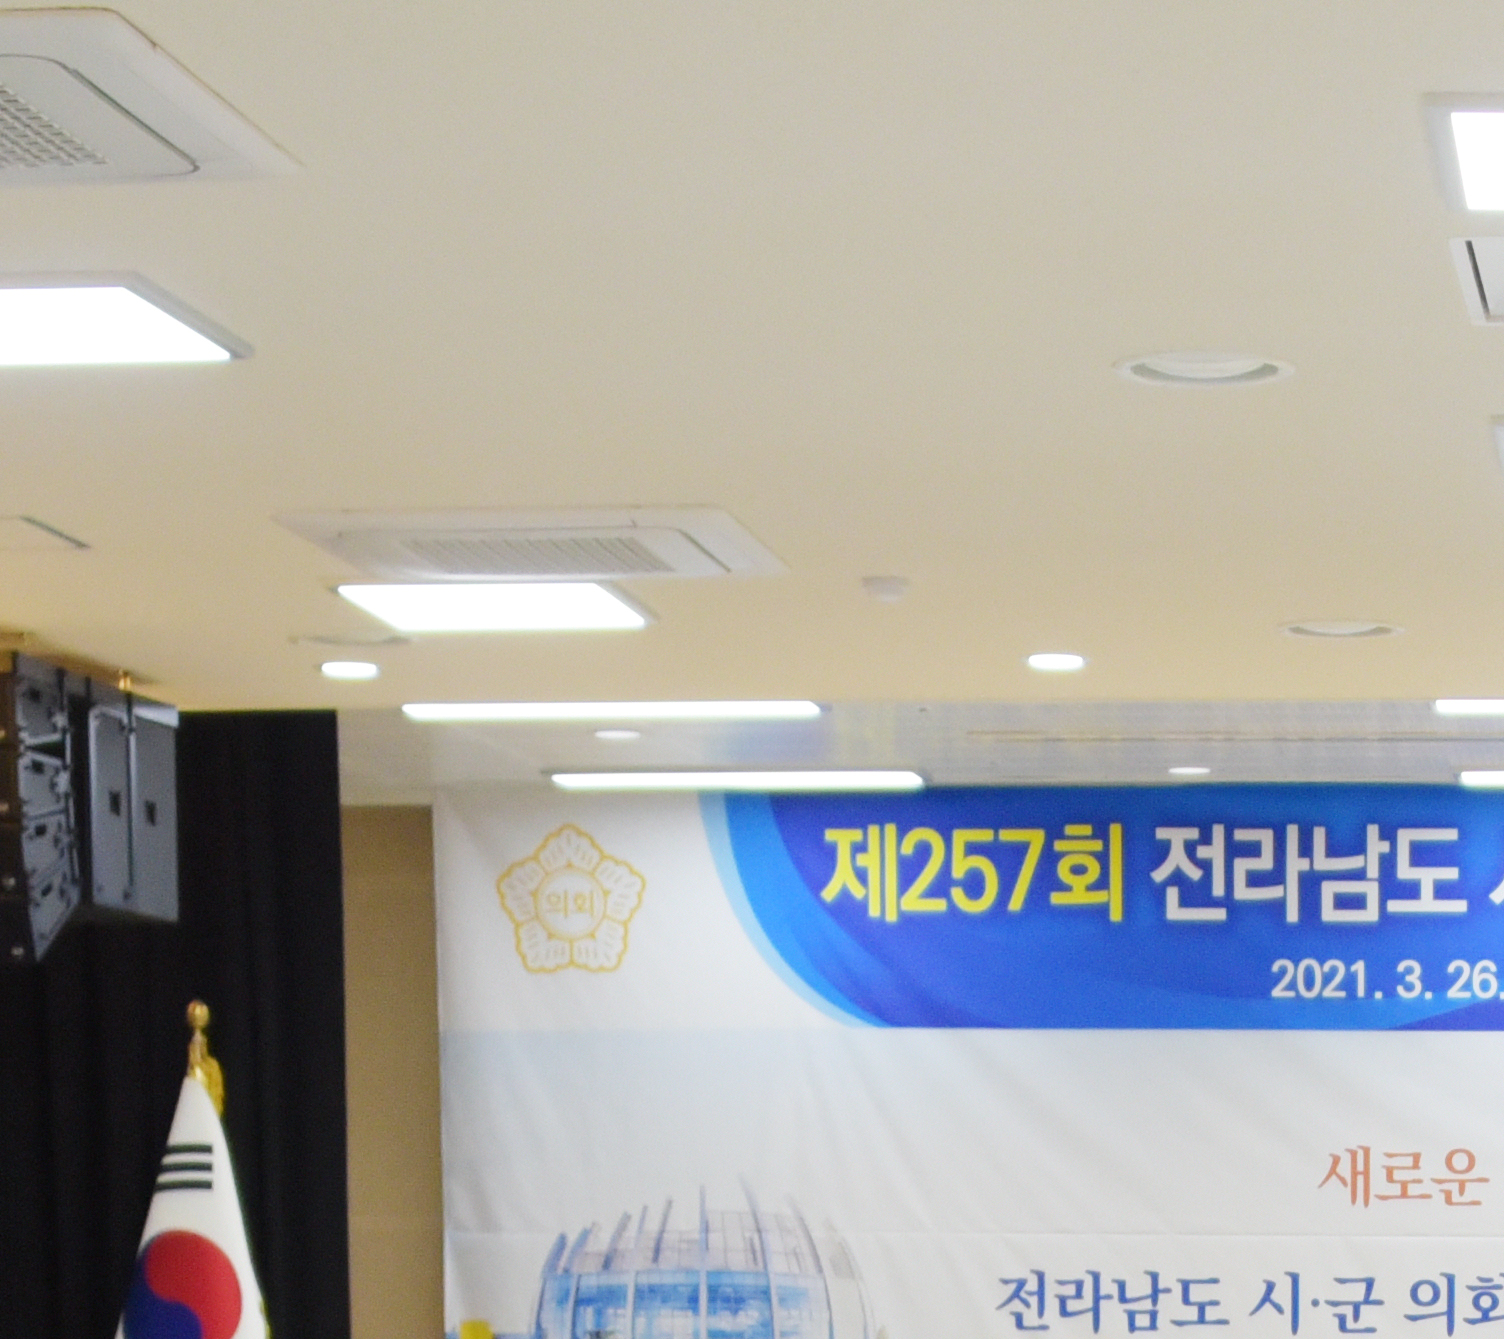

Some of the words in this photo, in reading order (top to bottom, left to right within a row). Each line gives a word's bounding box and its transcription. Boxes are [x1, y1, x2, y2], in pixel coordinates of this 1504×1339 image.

[821, 823, 1123, 923] 제257회
[1151, 824, 1468, 923] 전라남도
[1271, 957, 1383, 1000] 2021.
[1397, 959, 1433, 1001] 3.
[1319, 1145, 1490, 1208] 새로운
[998, 1269, 1230, 1334] 전라남도
[1249, 1271, 1385, 1336] 시·군
